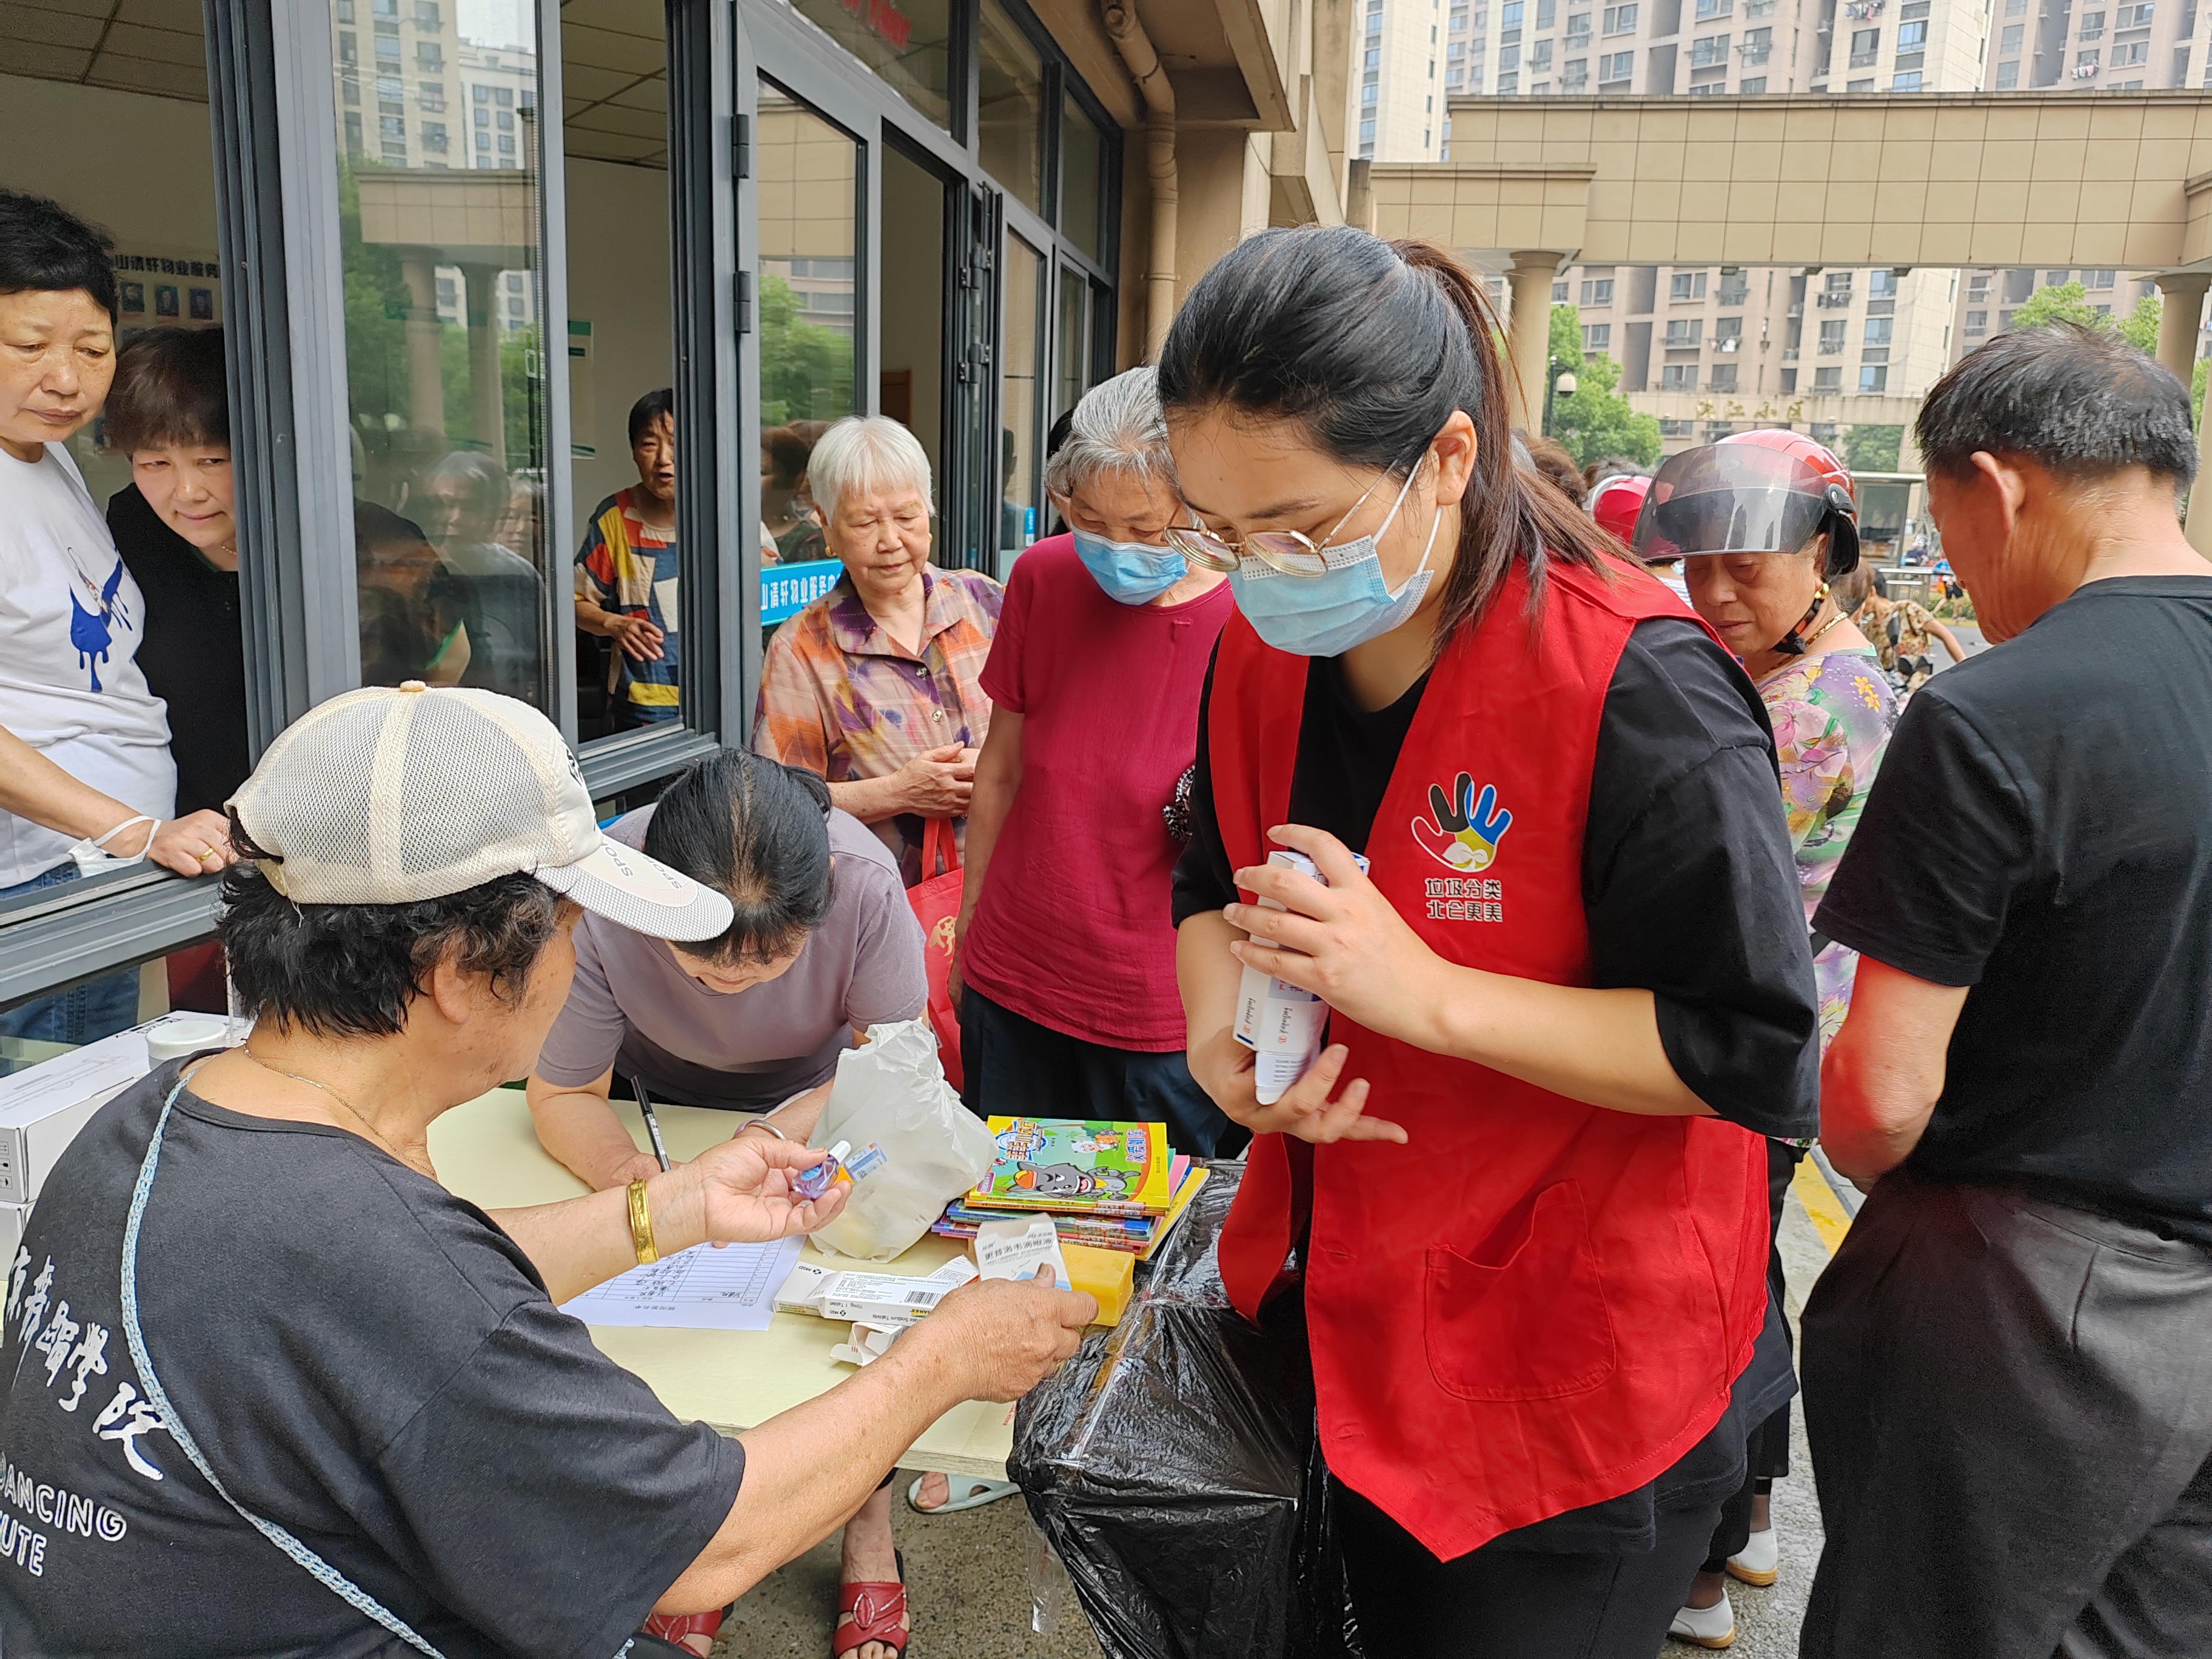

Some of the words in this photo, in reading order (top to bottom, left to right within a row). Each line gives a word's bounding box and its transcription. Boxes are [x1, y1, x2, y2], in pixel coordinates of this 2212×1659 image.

[761, 573, 842, 611] 山清轩物业服务中
[1425, 877, 1503, 900] 垃圾分类
[1426, 899, 1504, 923] 北仑更美
[0, 1510, 47, 1577] UTE
